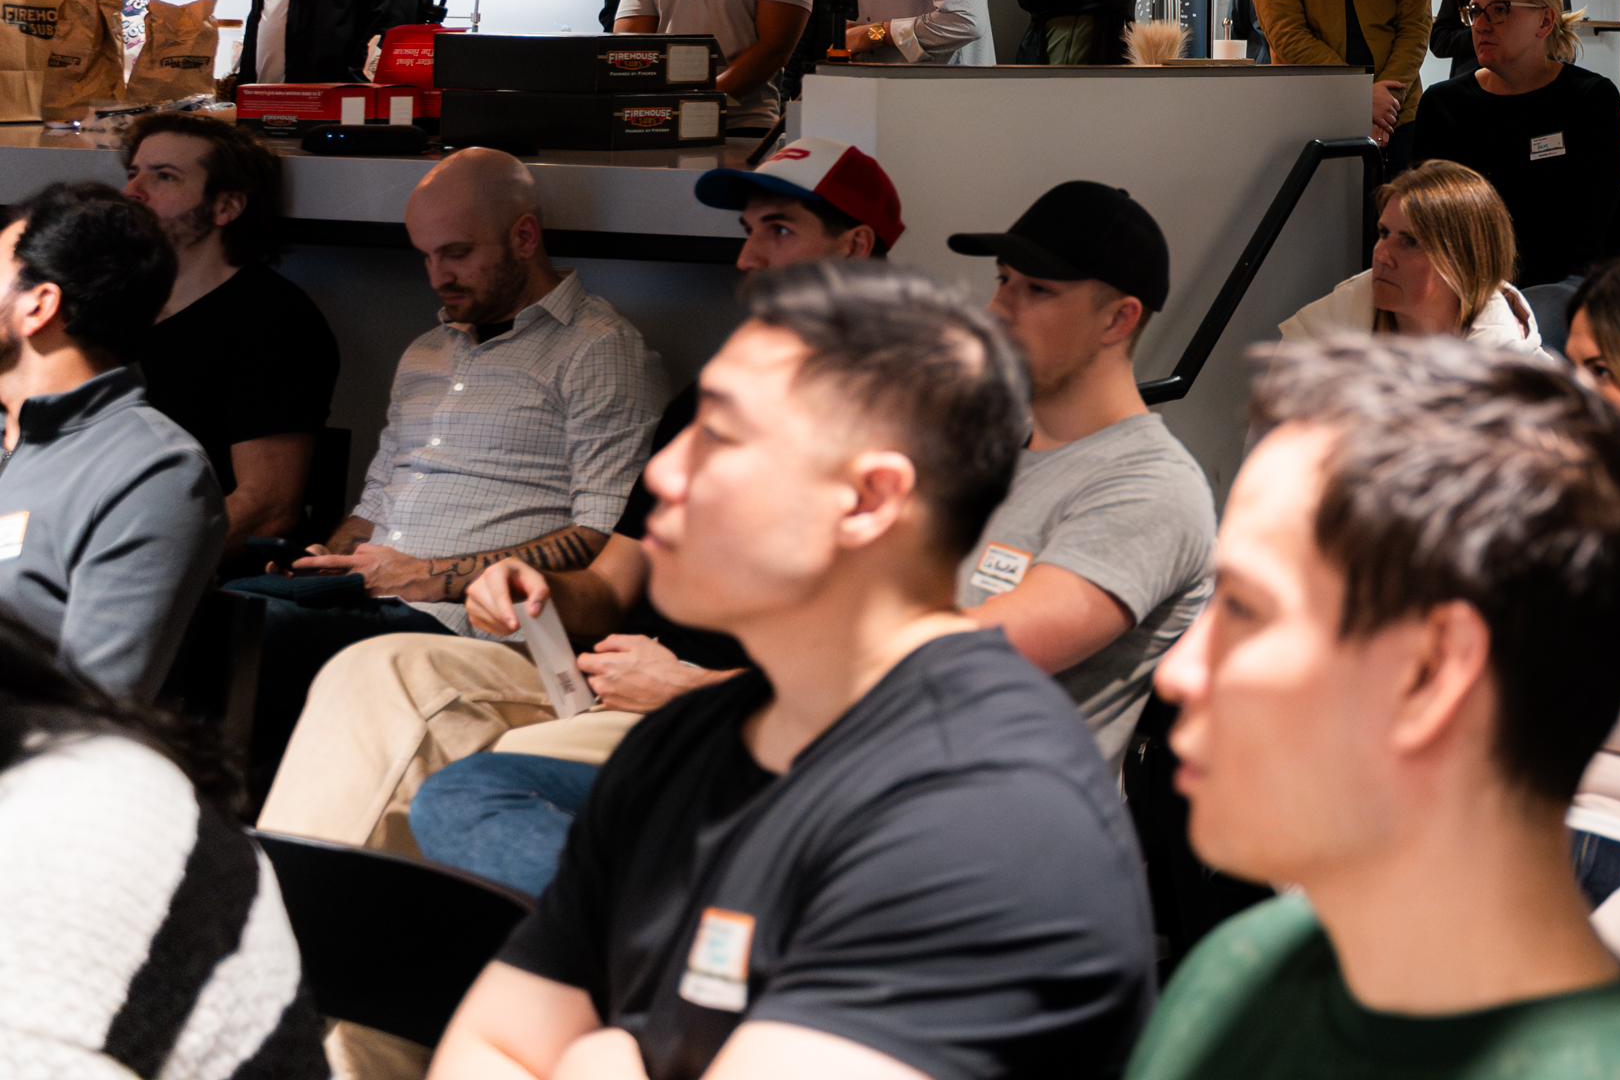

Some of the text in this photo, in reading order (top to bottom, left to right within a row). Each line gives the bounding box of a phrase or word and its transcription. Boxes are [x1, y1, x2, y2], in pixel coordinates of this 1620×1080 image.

[5, 7, 58, 24] FIREHO
[30, 23, 54, 36] SUB
[393, 48, 420, 57] Rescue
[415, 58, 434, 66] etter
[609, 53, 659, 64] FIREHOUSE
[624, 60, 644, 68] SUBS
[624, 110, 672, 121] FIREHOUSE
